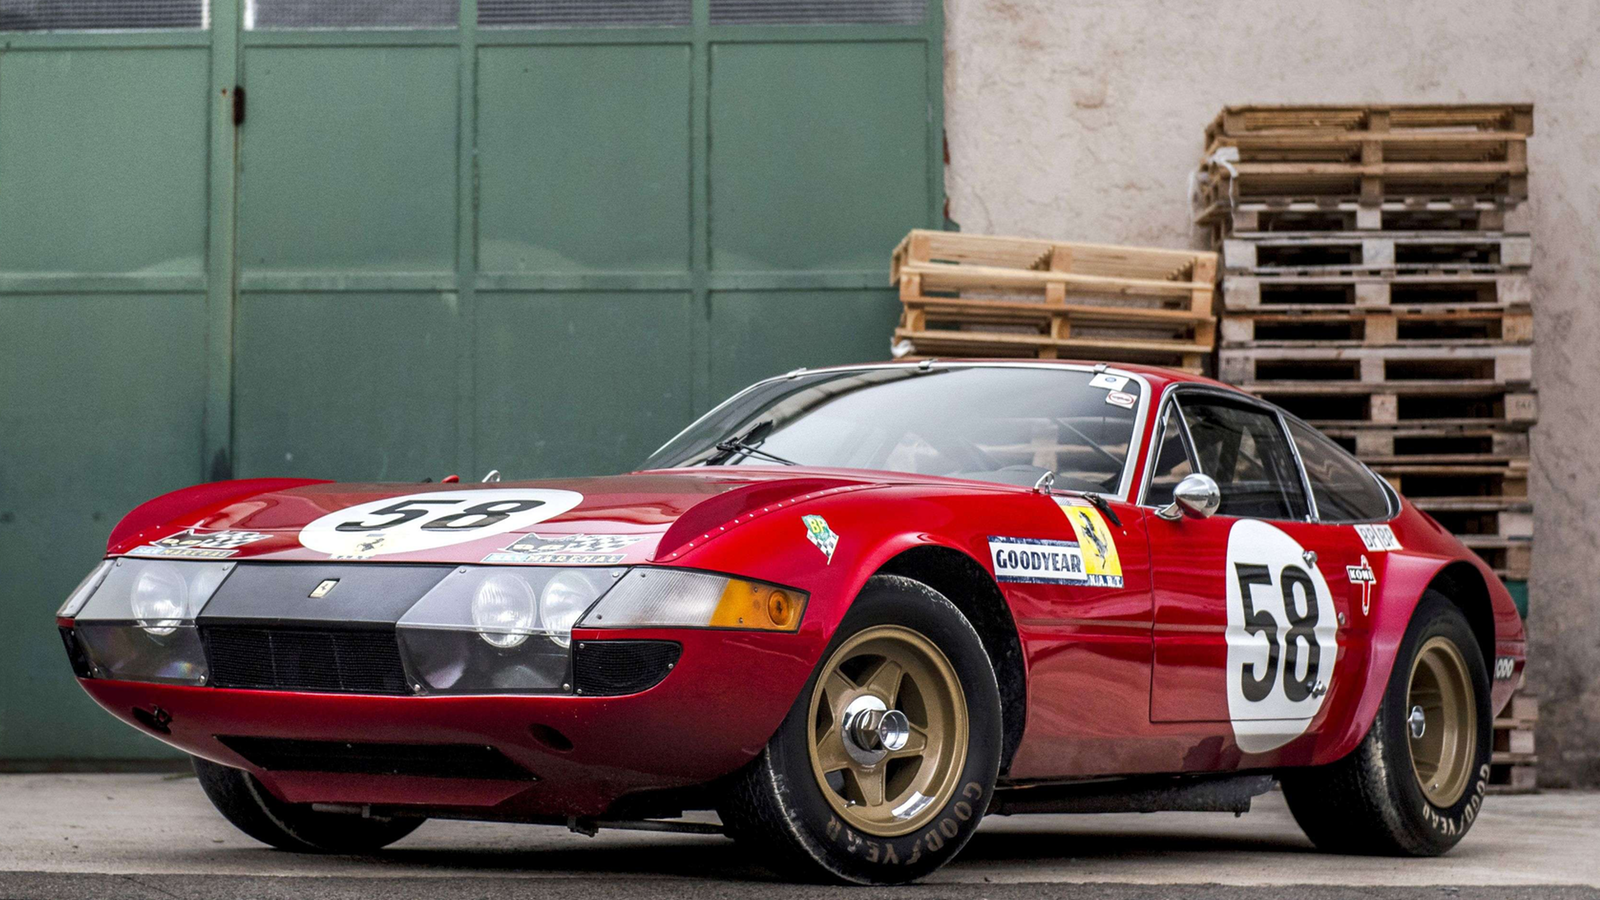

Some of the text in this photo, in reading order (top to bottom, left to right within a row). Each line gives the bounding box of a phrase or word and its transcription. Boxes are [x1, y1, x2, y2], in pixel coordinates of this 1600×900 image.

[335, 499, 546, 532] 58
[996, 549, 1082, 573] GOODYEAR
[1350, 569, 1373, 580] KONI
[1234, 561, 1321, 703] 58
